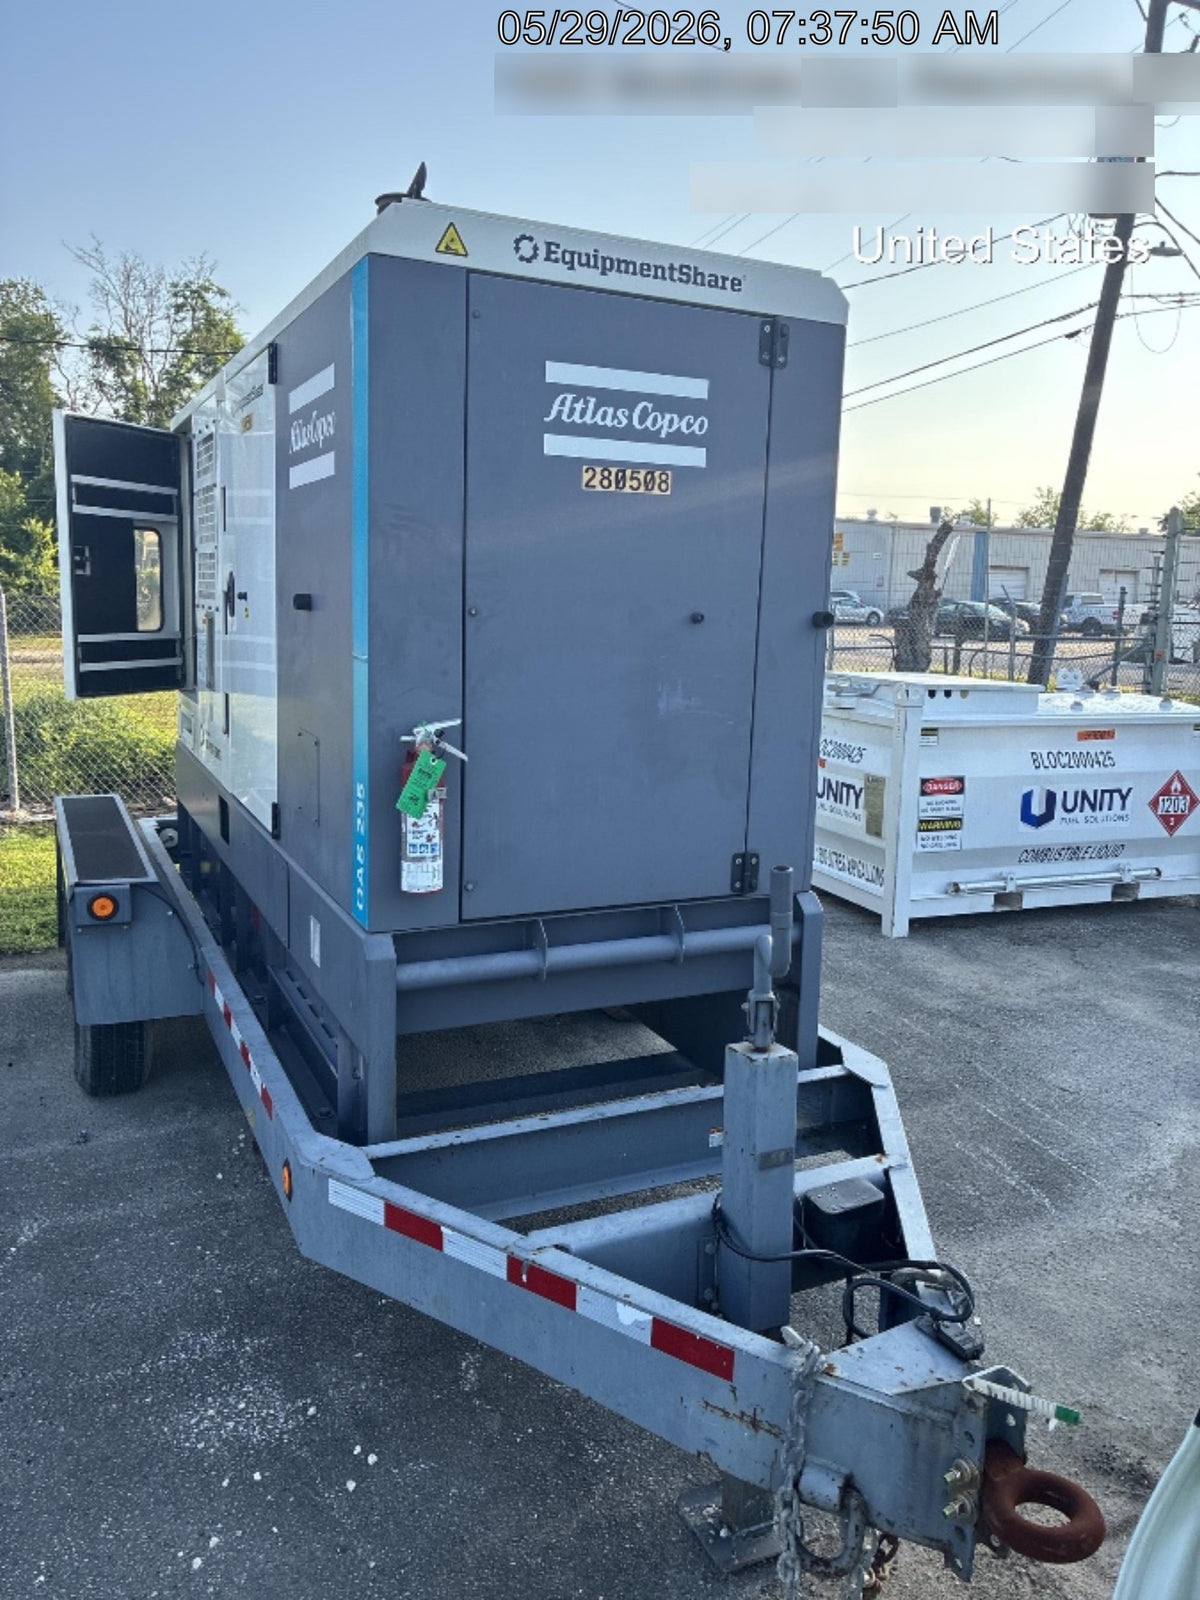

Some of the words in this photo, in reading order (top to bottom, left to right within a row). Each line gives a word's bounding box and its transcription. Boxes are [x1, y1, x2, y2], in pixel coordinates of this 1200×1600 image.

[544, 240, 743, 293] EquipmentShare
[544, 392, 629, 429] Atlas
[632, 401, 709, 438] Copco
[583, 467, 671, 494] 280508
[1031, 751, 1116, 769] BLOC2000425
[1061, 787, 1133, 814] UNITY
[1160, 797, 1188, 814] 1203
[920, 821, 961, 831] WARNING
